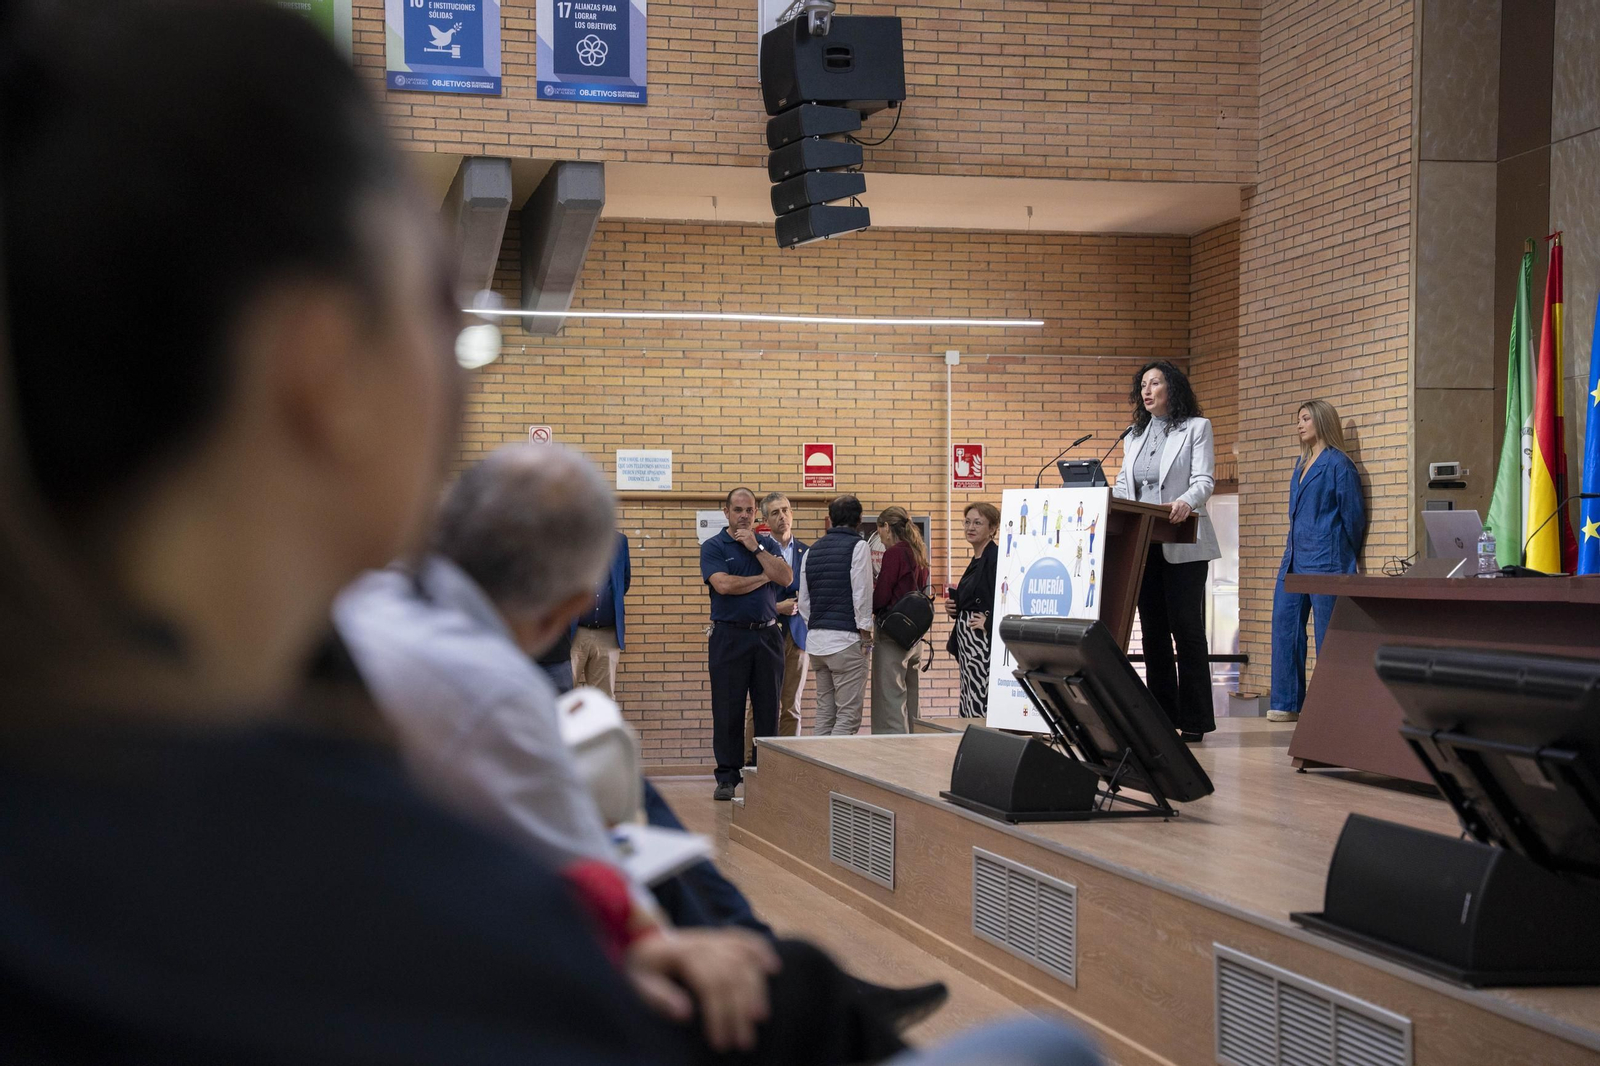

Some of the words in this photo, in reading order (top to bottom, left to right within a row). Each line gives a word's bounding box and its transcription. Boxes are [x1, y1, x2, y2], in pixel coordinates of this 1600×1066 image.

[434, 2, 476, 11] INSTITUCIONES
[557, 2, 572, 18] 17
[575, 3, 600, 11] ALIANZAS
[429, 10, 453, 19] SÓLIDAS
[575, 12, 597, 20] LOGRAR
[575, 21, 586, 29] LOS
[587, 22, 617, 30] OBJETIVOS
[432, 79, 471, 88] OBJETIVOS
[580, 89, 618, 98] OBJETIVOS
[1028, 576, 1064, 595] ALMERÍA
[1030, 598, 1059, 615] SOCIAL
[1012, 689, 1017, 697] la
